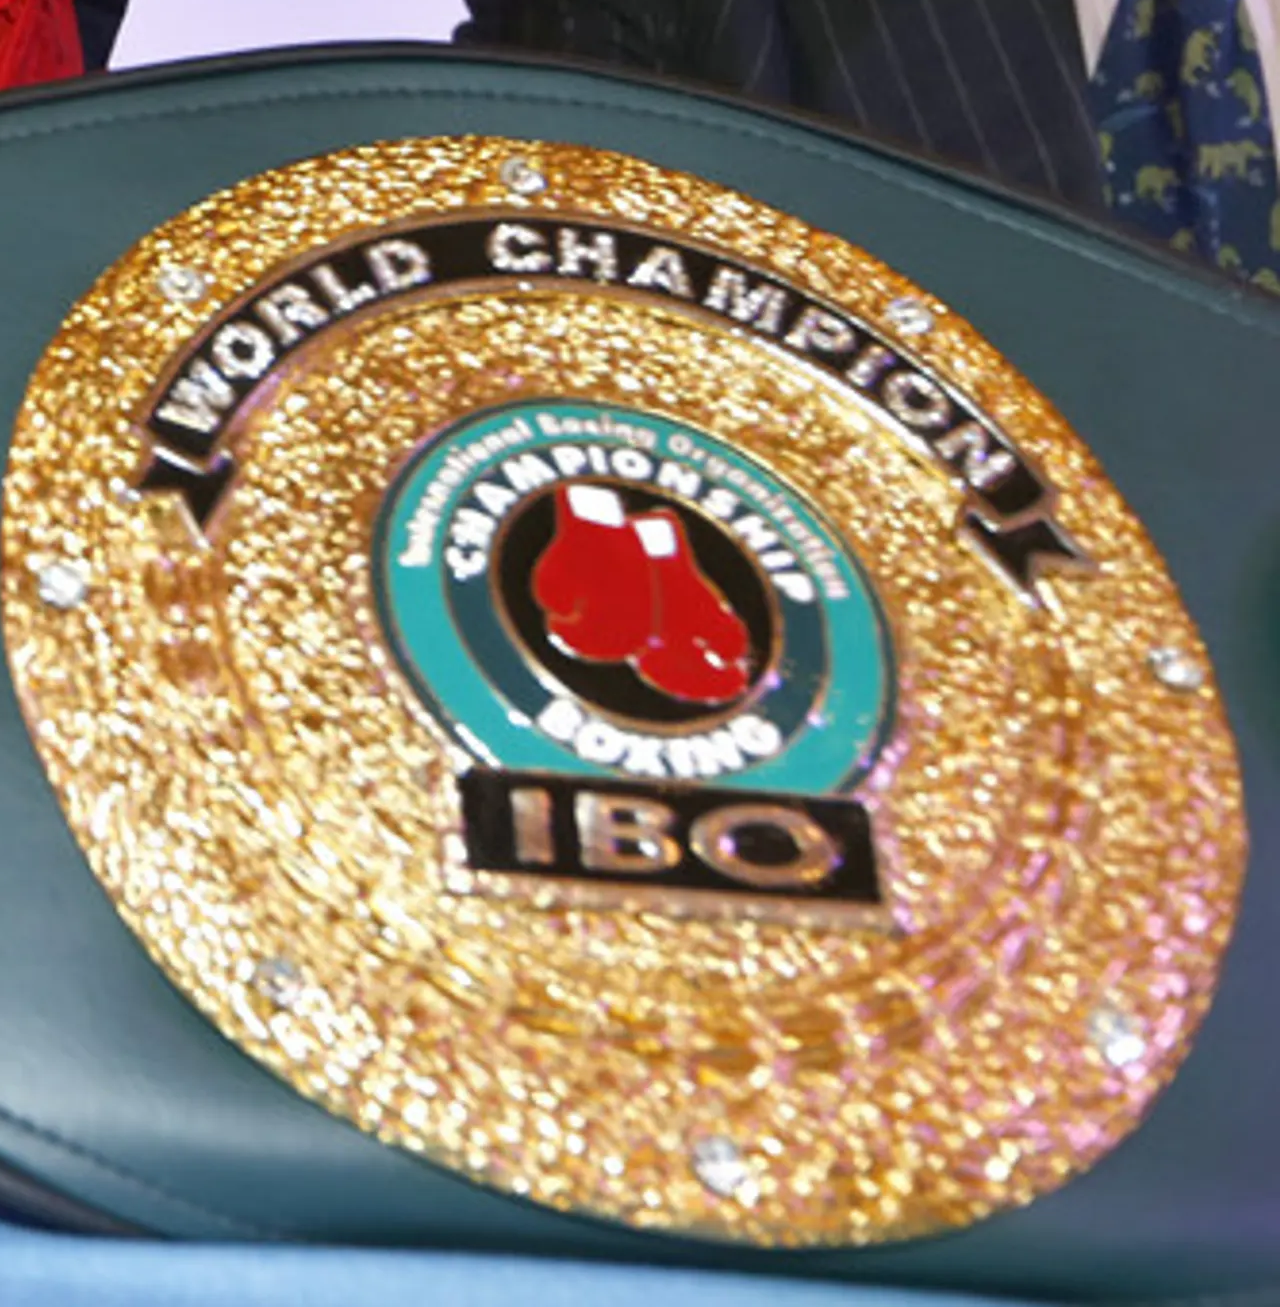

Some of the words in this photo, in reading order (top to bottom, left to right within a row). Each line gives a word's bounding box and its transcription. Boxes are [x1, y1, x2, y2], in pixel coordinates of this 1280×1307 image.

[156, 237, 431, 434] WORLD
[486, 222, 1016, 492] CHAMPION
[536, 412, 657, 449] Boxing
[444, 445, 814, 603] CHAMPIONSHIP
[537, 697, 781, 778] BOXING
[510, 786, 839, 888] IBO
